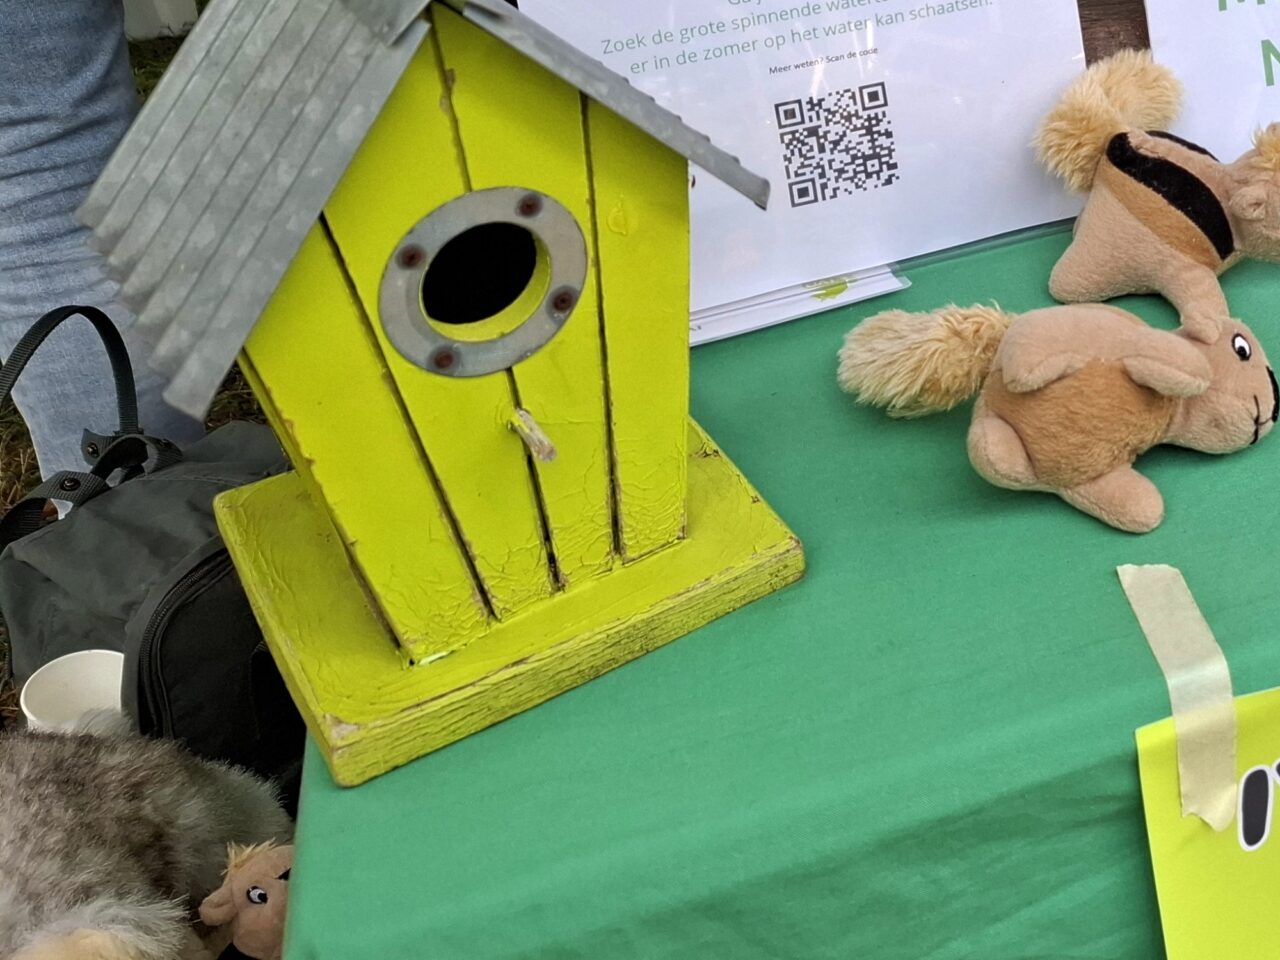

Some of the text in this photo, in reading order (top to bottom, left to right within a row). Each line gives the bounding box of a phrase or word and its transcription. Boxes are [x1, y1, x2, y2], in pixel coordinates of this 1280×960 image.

[601, 33, 647, 55] Zoek
[651, 29, 674, 46] de
[679, 21, 727, 44] grote
[731, 2, 822, 29] spinnende
[630, 59, 649, 74] er
[653, 54, 671, 71] in
[675, 50, 698, 66] de
[703, 38, 759, 61] zomer
[763, 33, 787, 51] op
[790, 27, 819, 43] het
[822, 18, 871, 38] water
[874, 11, 905, 28] kan
[768, 64, 792, 75] Meer
[793, 56, 824, 70] weten?
[825, 54, 845, 64] Scan
[846, 50, 857, 60] de
